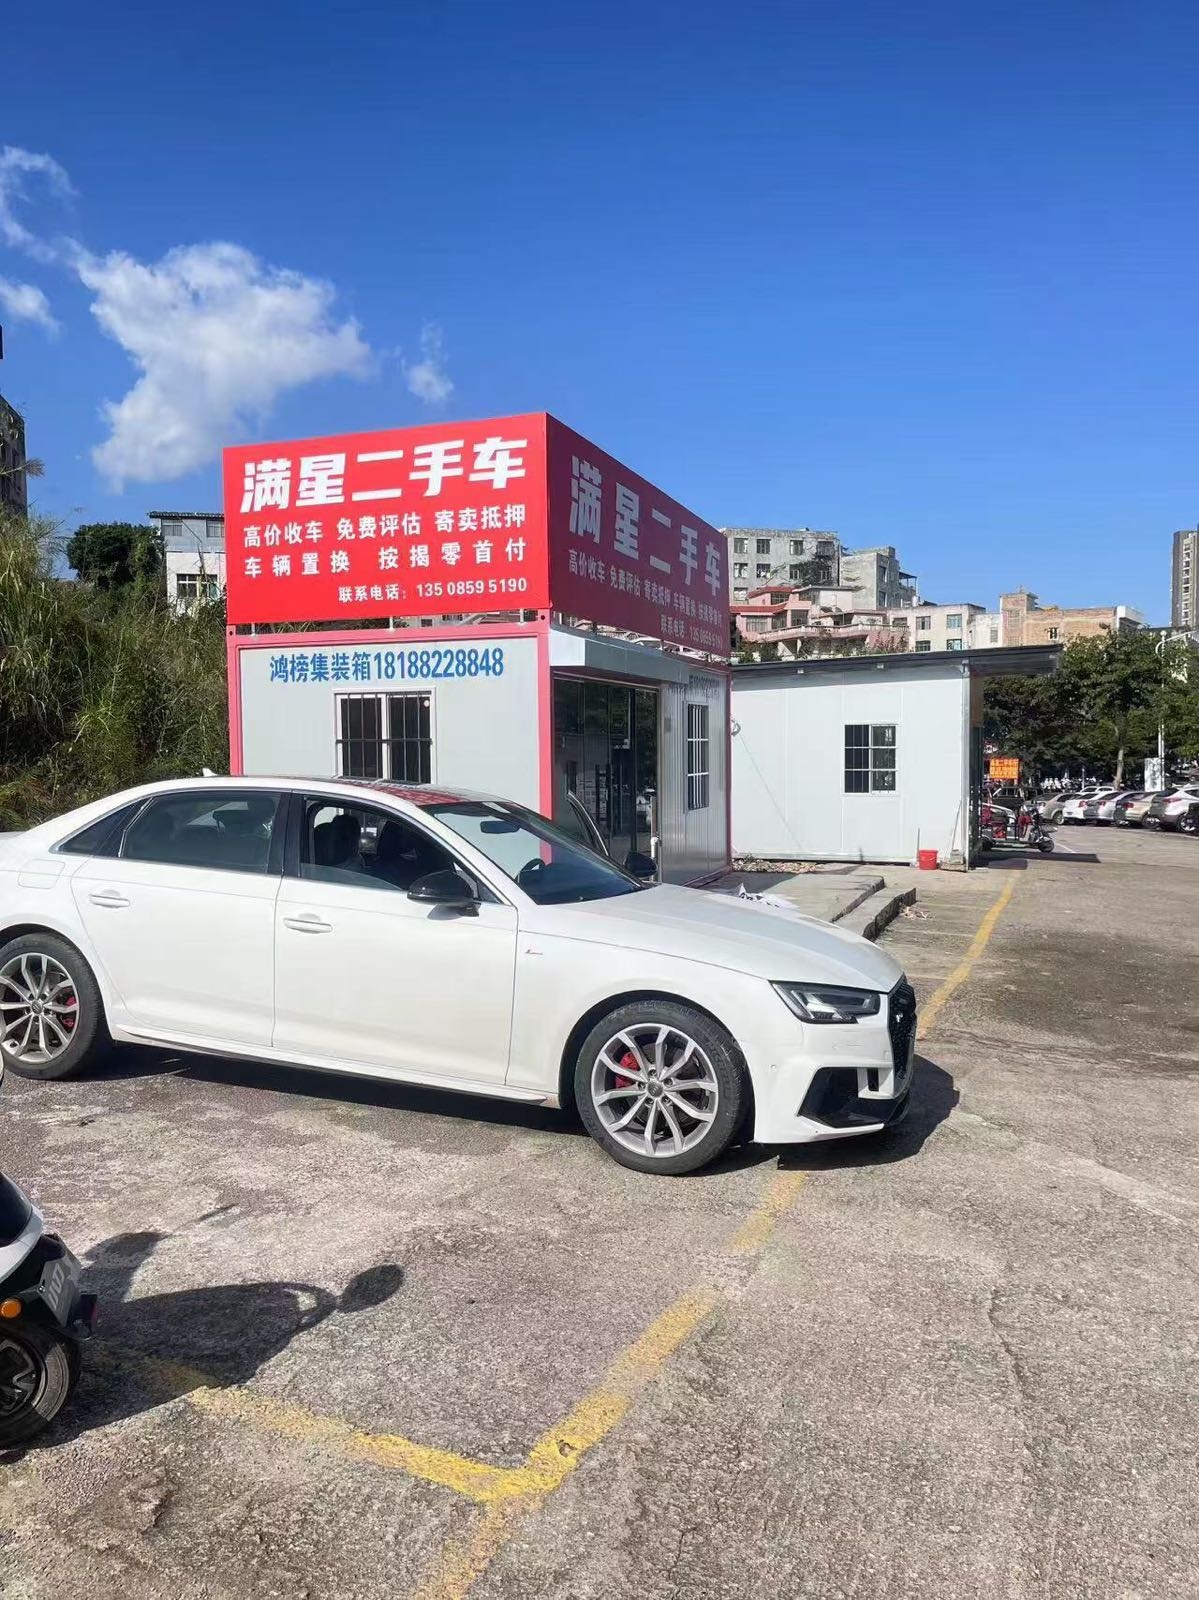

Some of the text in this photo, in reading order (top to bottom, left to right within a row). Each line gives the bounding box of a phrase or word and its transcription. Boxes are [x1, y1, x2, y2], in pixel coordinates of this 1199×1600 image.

[239, 436, 528, 513] 满星二手车
[243, 503, 527, 549] 高价收车 免费评估 寄卖抵押
[569, 455, 721, 597] 满星二手车
[244, 537, 527, 579] 车辆置换 按揭零首付
[568, 548, 606, 583] 高价收车
[416, 582, 443, 598] 135
[447, 580, 485, 596] 0859
[488, 577, 527, 594] 5190
